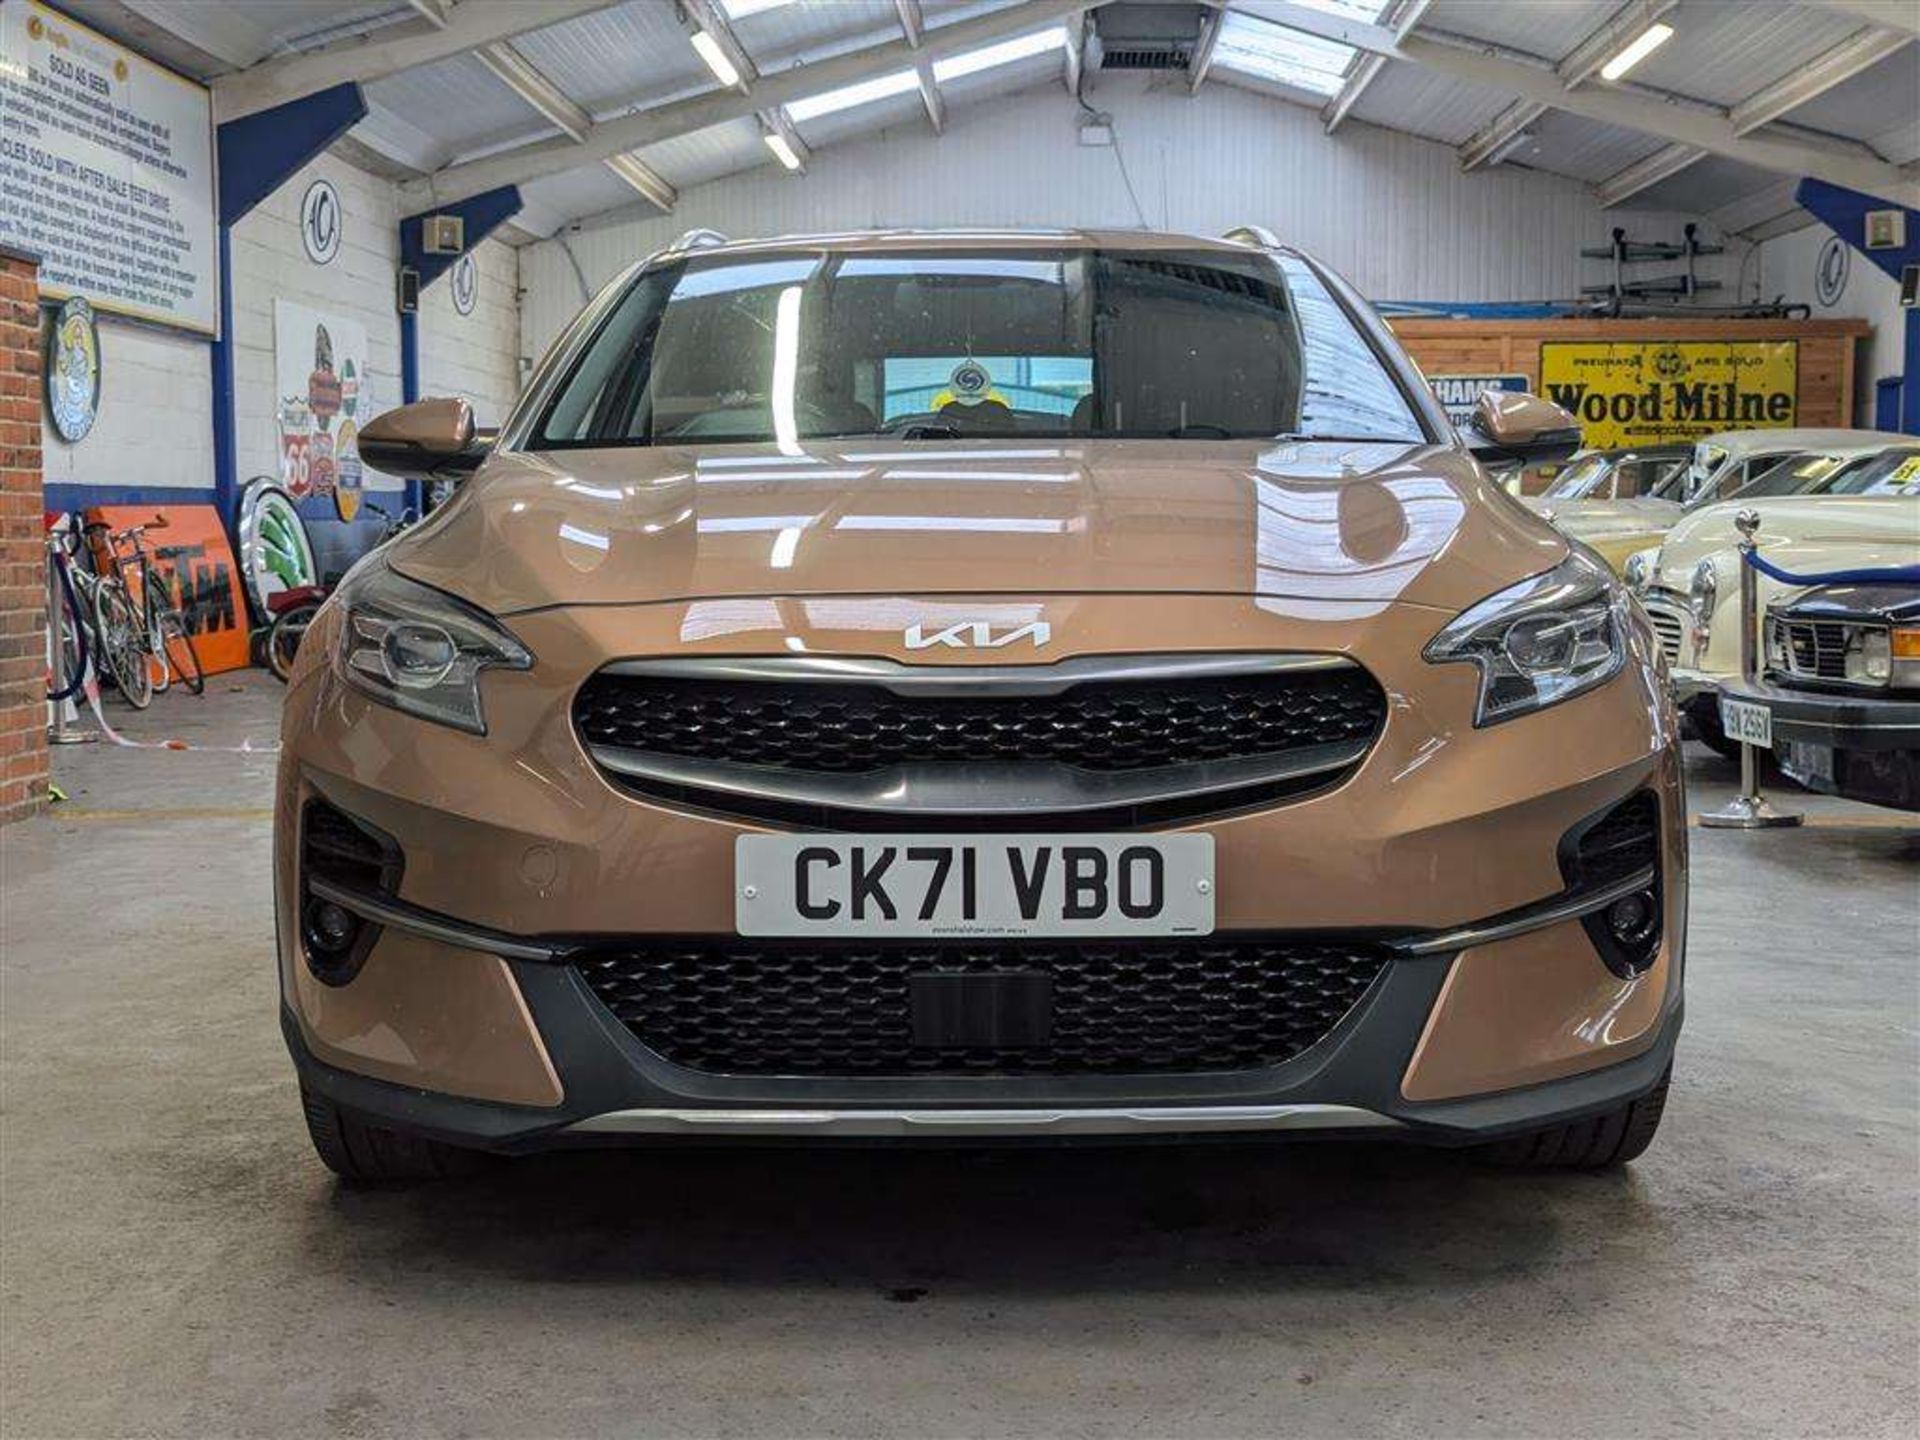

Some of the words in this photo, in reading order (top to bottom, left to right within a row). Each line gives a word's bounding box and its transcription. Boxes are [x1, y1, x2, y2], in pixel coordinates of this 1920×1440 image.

[50, 53, 73, 81] SOLD
[75, 64, 86, 87] AS
[88, 71, 109, 97] SEEN
[28, 146, 53, 172] SOLD
[55, 156, 76, 180] WITH
[78, 164, 104, 189] AFTER
[106, 174, 127, 198] SALE
[129, 182, 147, 204] TEST
[149, 189, 169, 213] DRIVE
[286, 443, 310, 486] 66
[905, 622, 1051, 649] KIA
[795, 847, 976, 920] CK71
[1006, 846, 1164, 920] VBO
